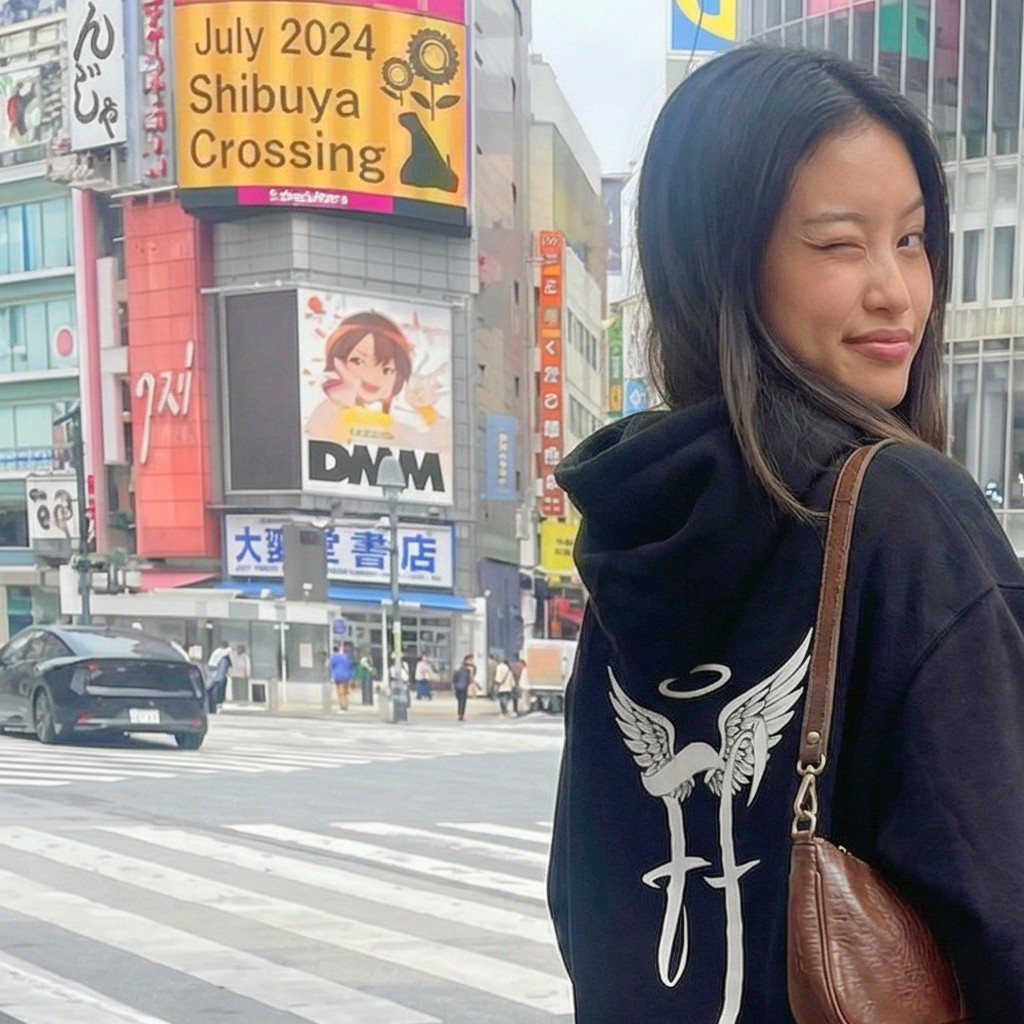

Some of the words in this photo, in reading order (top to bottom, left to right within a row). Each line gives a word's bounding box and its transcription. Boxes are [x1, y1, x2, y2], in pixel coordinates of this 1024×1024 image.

[195, 17, 264, 62] July
[280, 18, 376, 61] 2024
[189, 73, 360, 124] Shibuya
[190, 128, 386, 184] Crossing
